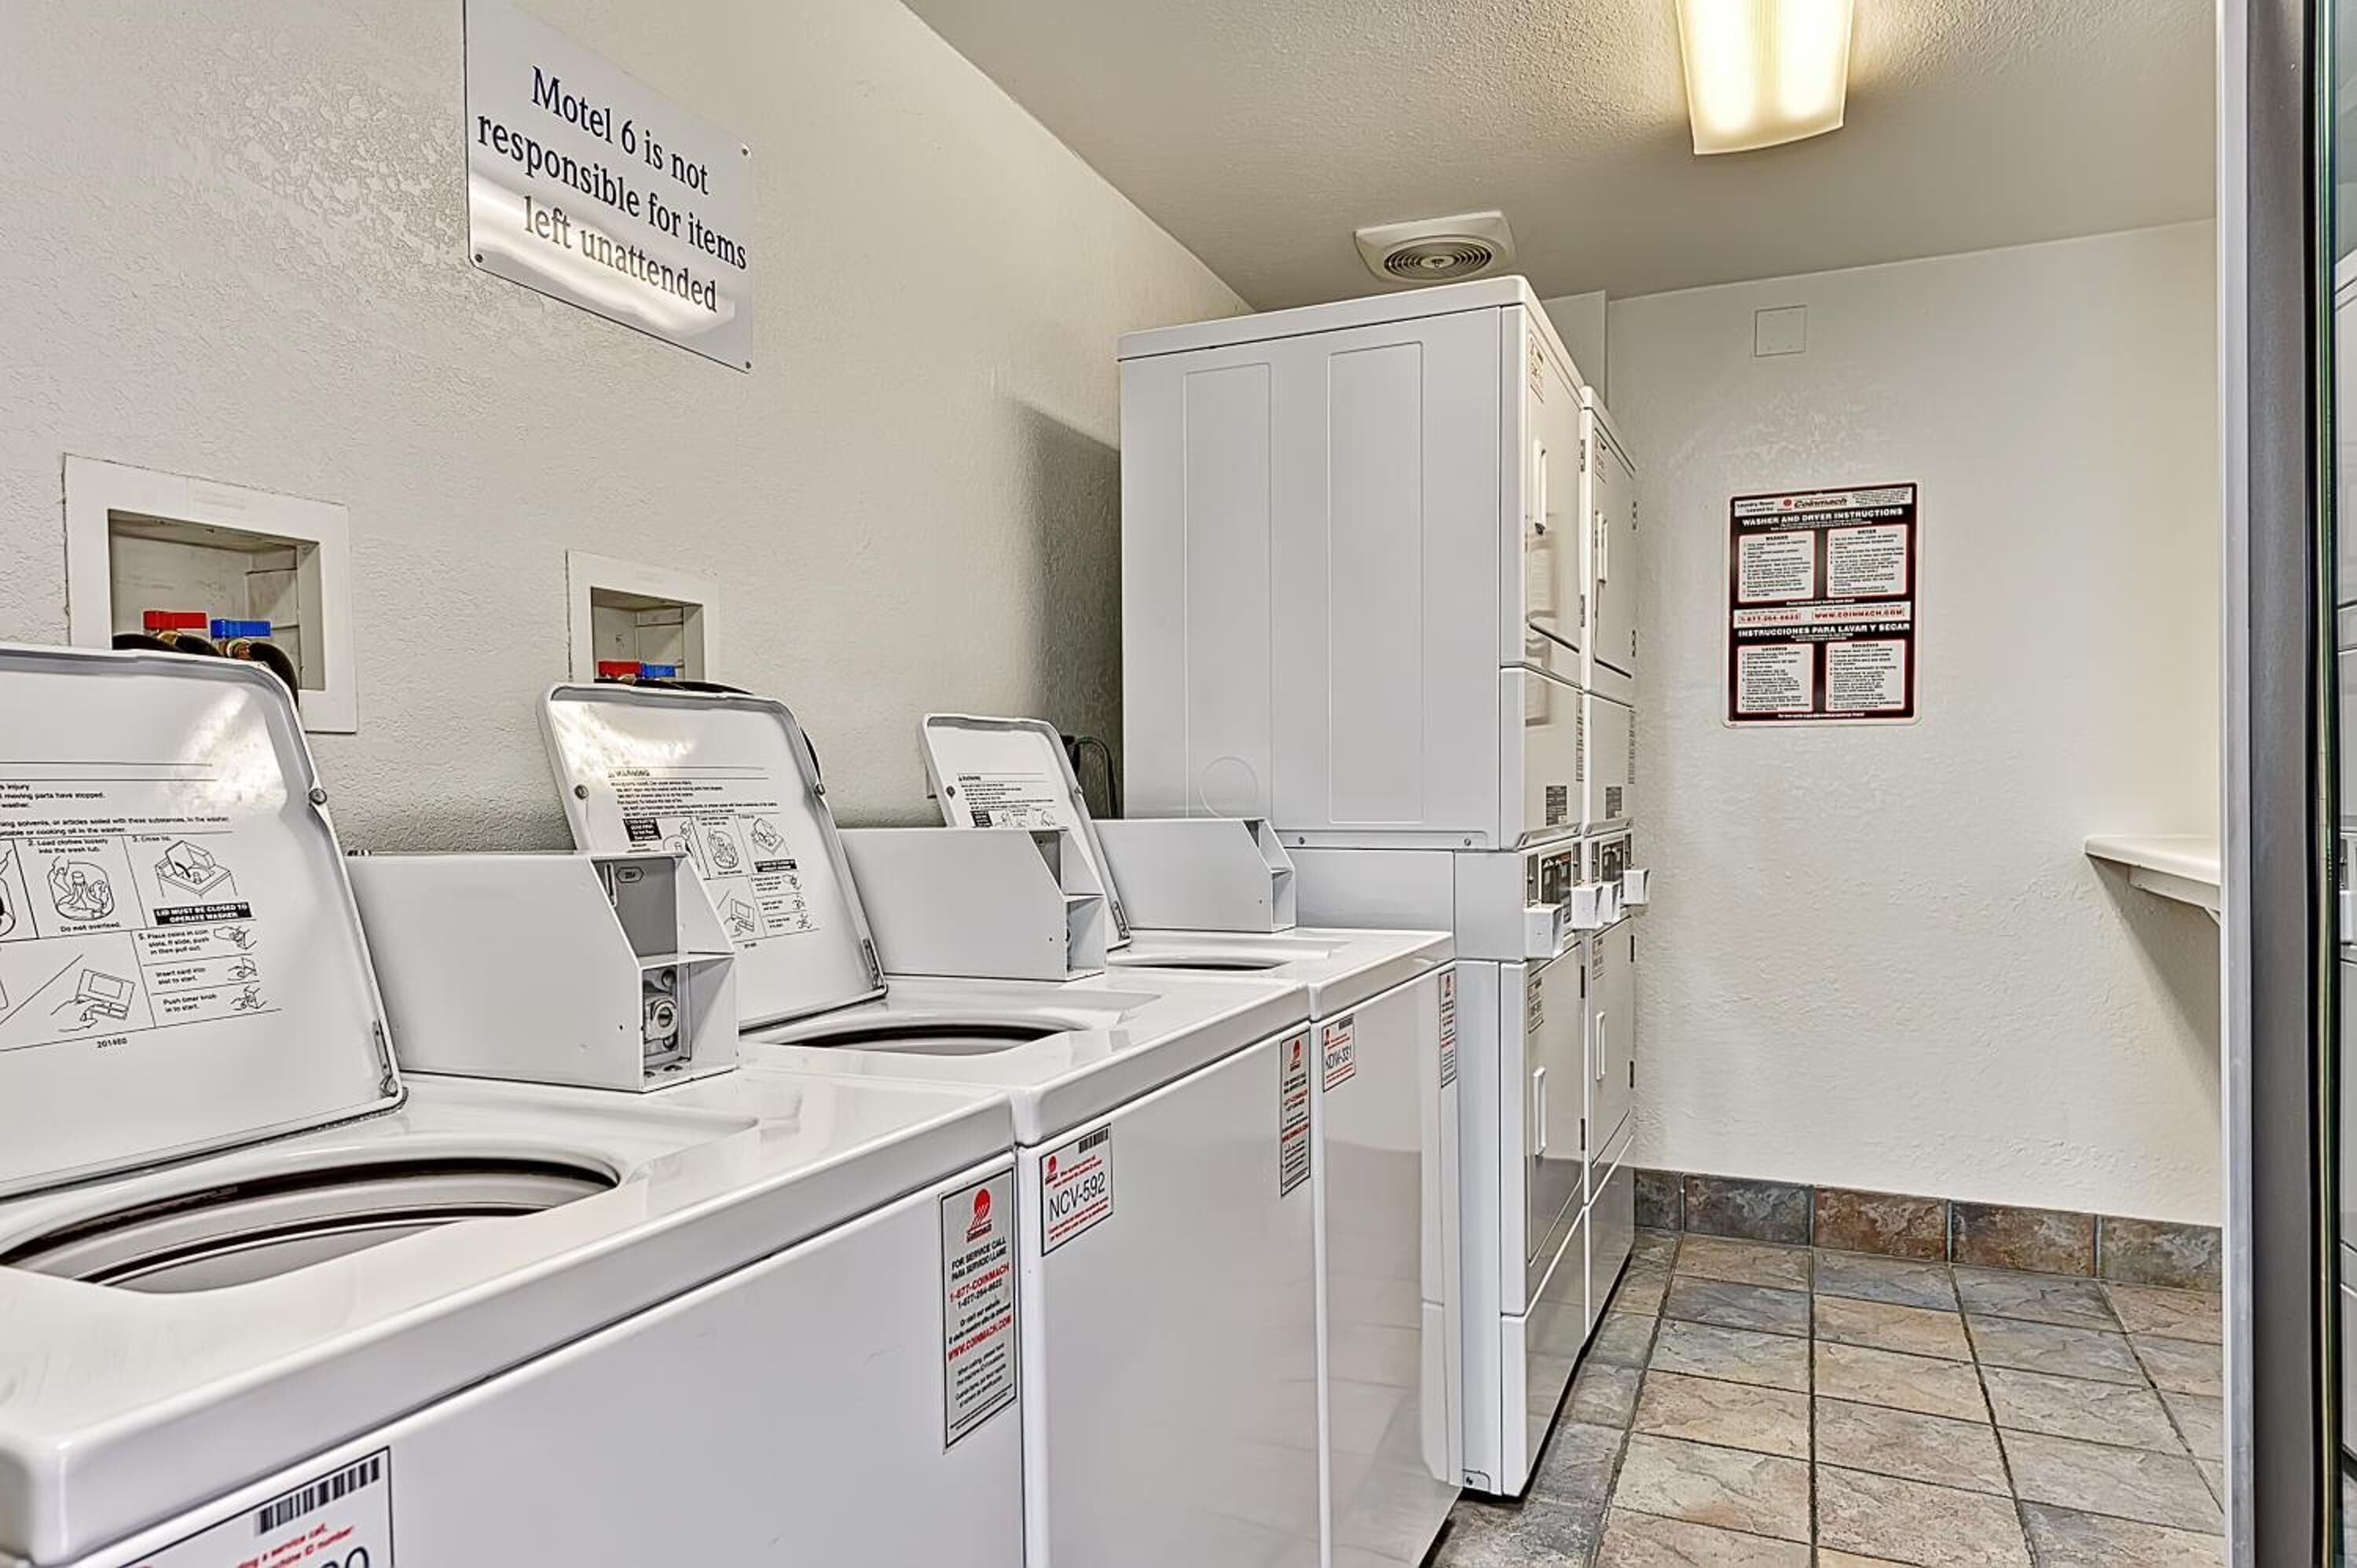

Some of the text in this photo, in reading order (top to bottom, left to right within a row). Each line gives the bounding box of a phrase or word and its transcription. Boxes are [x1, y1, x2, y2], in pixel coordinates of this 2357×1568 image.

[531, 65, 710, 196] Motel 6 is not
[476, 114, 747, 271] responsible for items
[523, 195, 718, 313] left unattended
[1794, 497, 1847, 508] Coinmach
[1742, 517, 1780, 526] WASHER
[1802, 513, 1832, 522] DRYER
[1833, 507, 1904, 520] INSTRUCTIONS
[1739, 626, 1810, 638] INSTRUCCIONES
[1812, 625, 1836, 634] PARA
[1838, 625, 1868, 633] LAVAR
[1879, 622, 1910, 632] SECAR
[169, 914, 205, 923] OPERATE
[1049, 1171, 1105, 1222] NCV-592
[951, 1235, 1006, 1270] FOR SERVICE CALL
[950, 1261, 1010, 1302] 1-877-COINMACH
[951, 1269, 966, 1282] PARA
[271, 1534, 307, 1558] service
[317, 1525, 354, 1550] number
